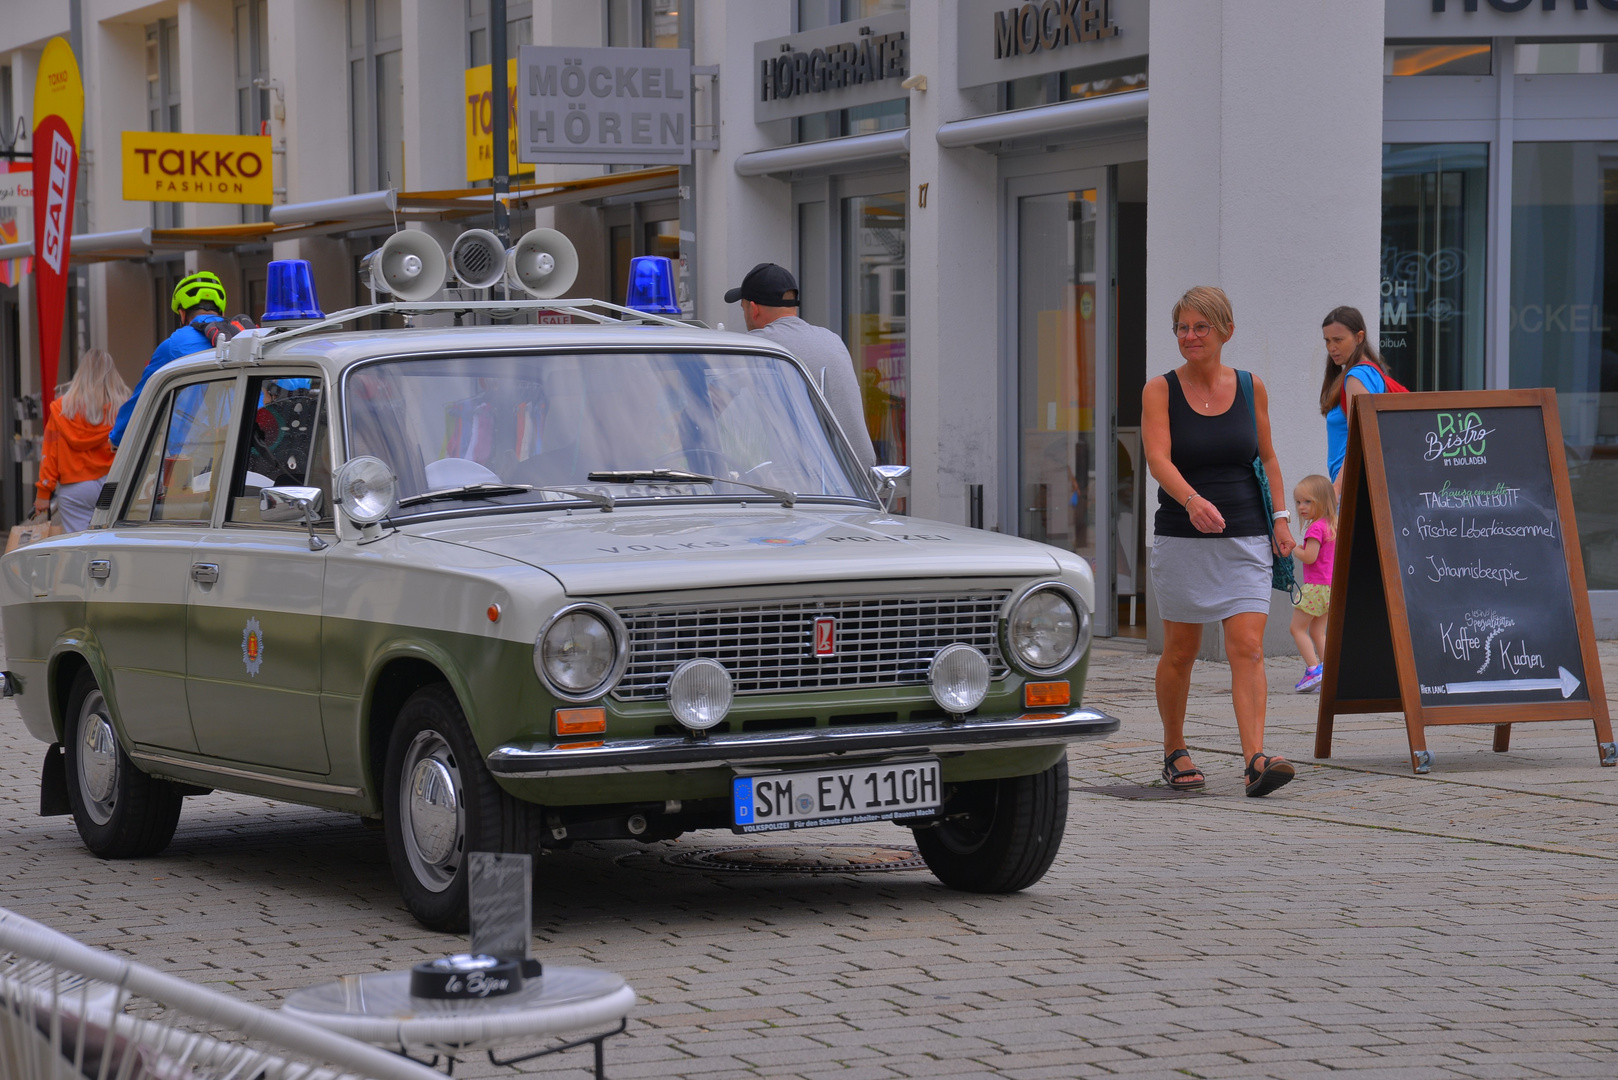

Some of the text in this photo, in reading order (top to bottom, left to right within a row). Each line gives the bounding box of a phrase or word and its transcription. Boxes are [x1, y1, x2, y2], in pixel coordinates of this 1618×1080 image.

[529, 58, 684, 98] MÖCKEL
[761, 26, 905, 102] HÖRGERÄTE
[530, 103, 684, 145] HÖREN
[46, 140, 69, 264] SALE
[156, 180, 243, 193] FASHION
[918, 182, 929, 208] 17
[1423, 419, 1496, 461] Bistro
[1453, 456, 1487, 466] BIOLADEN
[597, 533, 952, 554] VOLKS POLIZEI
[1440, 622, 1480, 660] Kaffee
[1500, 640, 1545, 675] Kuchen
[756, 767, 937, 817] SM EX 110H
[740, 806, 748, 817] D
[743, 822, 790, 833] VOLKSPOLIZEI
[794, 820, 806, 828] Für
[805, 819, 819, 827] den
[819, 815, 841, 825] Schutz
[853, 814, 880, 822] Arbeiter-
[894, 810, 915, 818] Bauern
[916, 808, 935, 816] Macht
[445, 971, 509, 997] le Bijou
